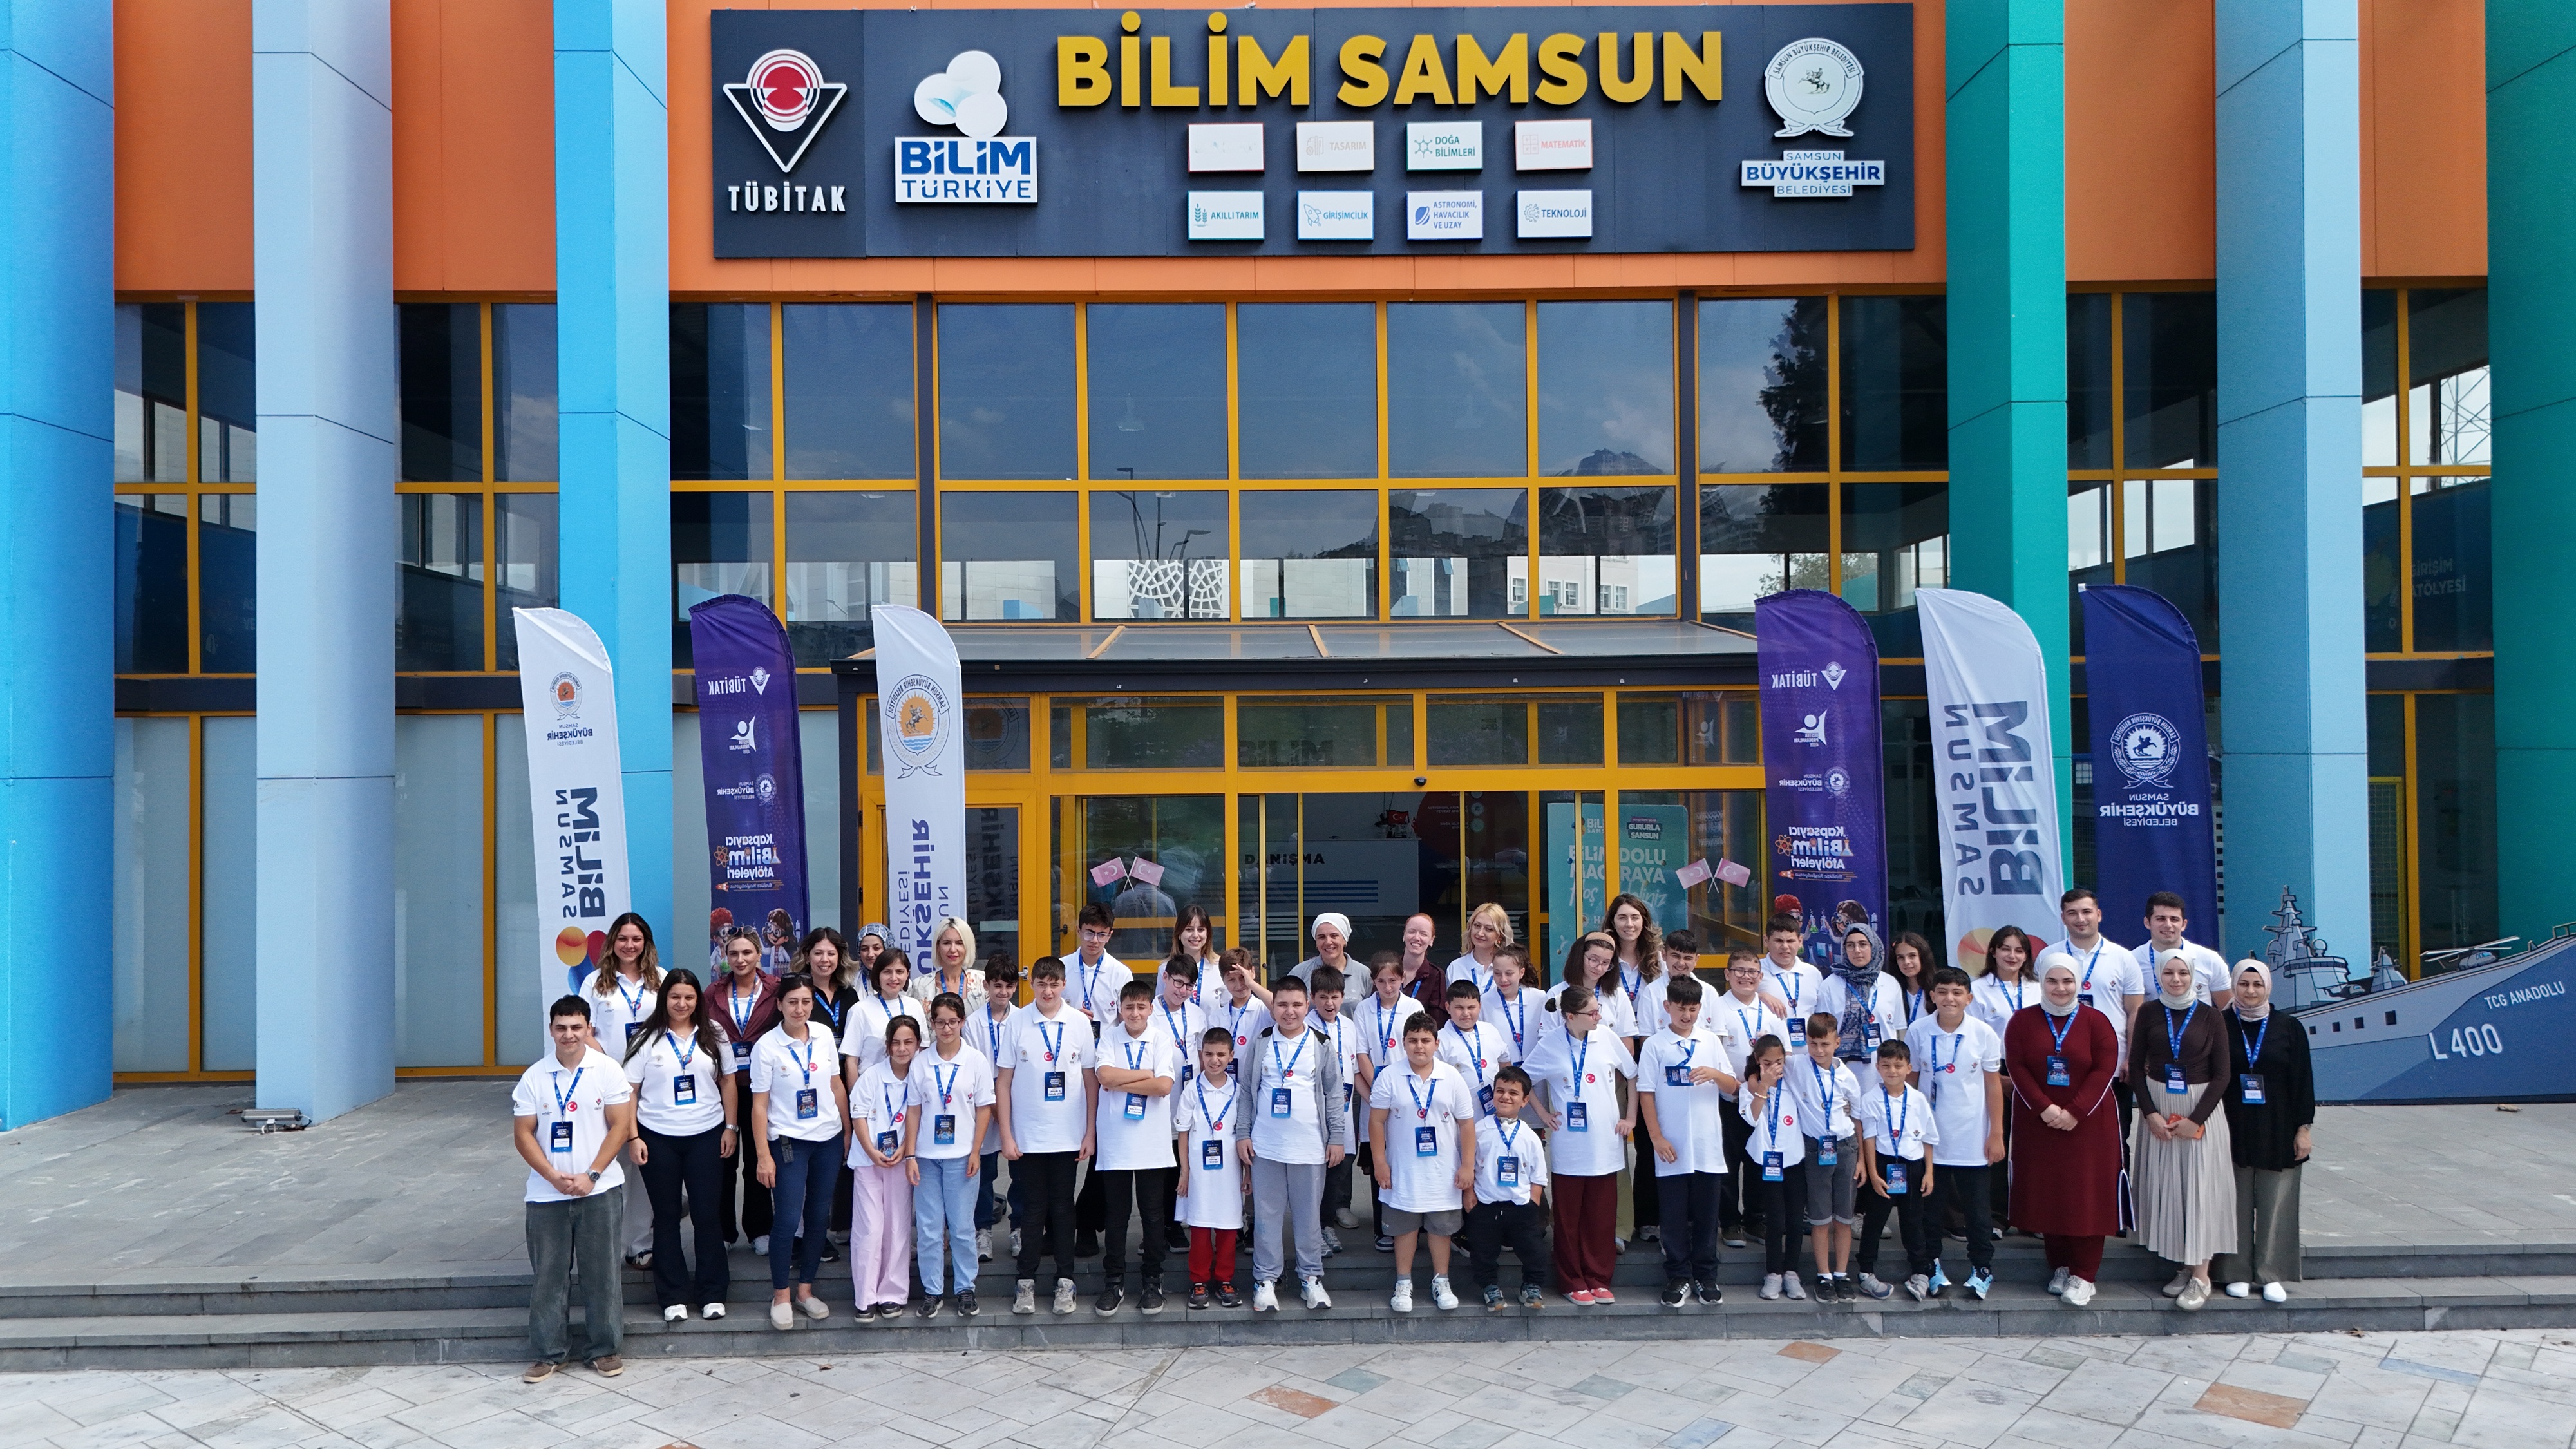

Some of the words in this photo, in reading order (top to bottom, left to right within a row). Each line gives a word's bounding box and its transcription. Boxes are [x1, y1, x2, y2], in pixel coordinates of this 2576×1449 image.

[1057, 11, 1310, 107] BİLİM
[1337, 31, 1722, 108] SAMSUN
[1772, 52, 1793, 75] SAMSUN
[1792, 42, 1830, 56] BÜYÜKŞEHİR
[1830, 48, 1858, 73] BELEDİYESİ
[1329, 141, 1367, 151] TASARIM
[1435, 135, 1460, 146] DOĞA
[1540, 138, 1586, 150] MATEMATİK
[901, 141, 1031, 175] BİLİM
[1435, 146, 1475, 158] BİLİMLERİ
[1786, 153, 1842, 161] SAMSUN
[1746, 162, 1880, 183] BÜYÜKŞEHİR
[901, 180, 1031, 199] TÜRKİYE
[1777, 184, 1851, 194] BELEDİYESİ
[728, 181, 846, 212] TÜBİTAK
[1433, 199, 1477, 210] ASTRONOMİ,
[1211, 211, 1235, 220] AKILLI
[1236, 211, 1259, 220] TARIM
[1323, 209, 1368, 222] GİRİŞİMCİLİK
[1433, 211, 1470, 219] HAVACILIK
[1541, 207, 1587, 219] TEKNOLOJİ
[1433, 221, 1443, 229] VE
[1444, 221, 1462, 229] UZAY
[1587, 818, 1603, 828] BİL
[1631, 831, 1659, 840] SAMSUN
[1619, 847, 1667, 866] DOLU
[2484, 994, 2508, 1009] TCG
[2509, 981, 2566, 1005] ANADOLU
[2429, 1023, 2503, 1061] L400
